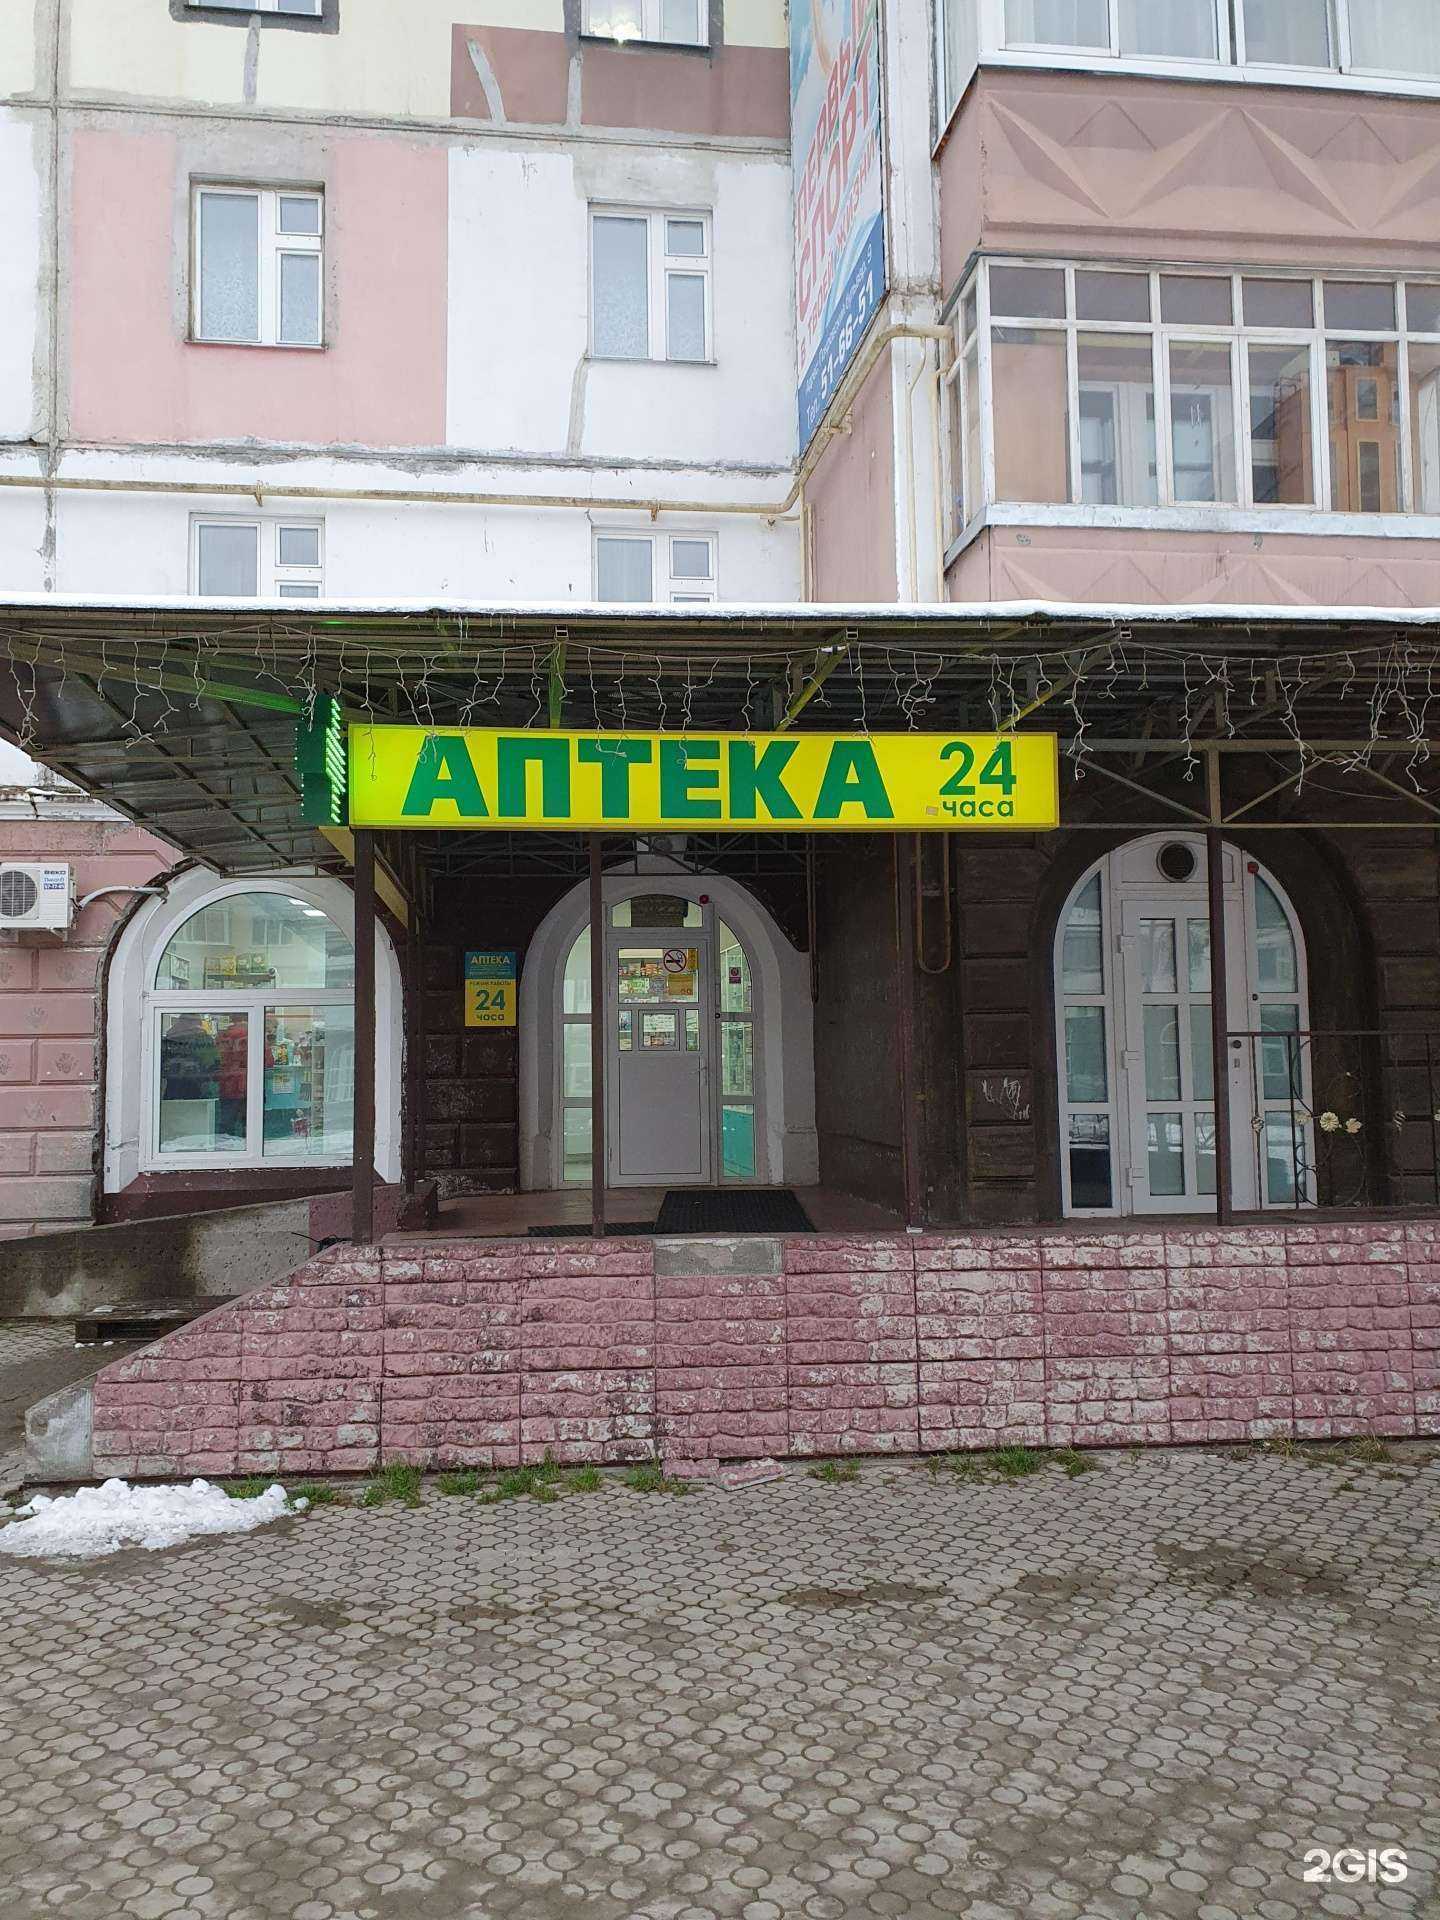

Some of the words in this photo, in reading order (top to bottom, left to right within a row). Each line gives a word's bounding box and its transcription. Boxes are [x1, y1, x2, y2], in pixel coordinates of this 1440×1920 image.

[799, 22, 875, 322] СПОРТ
[821, 270, 873, 401] 51-66-51
[401, 736, 896, 819] АПТЕКА
[939, 741, 1017, 796] 24
[942, 800, 1014, 818] часа
[471, 955, 510, 965] АПТЕКА
[475, 989, 506, 1011] 24
